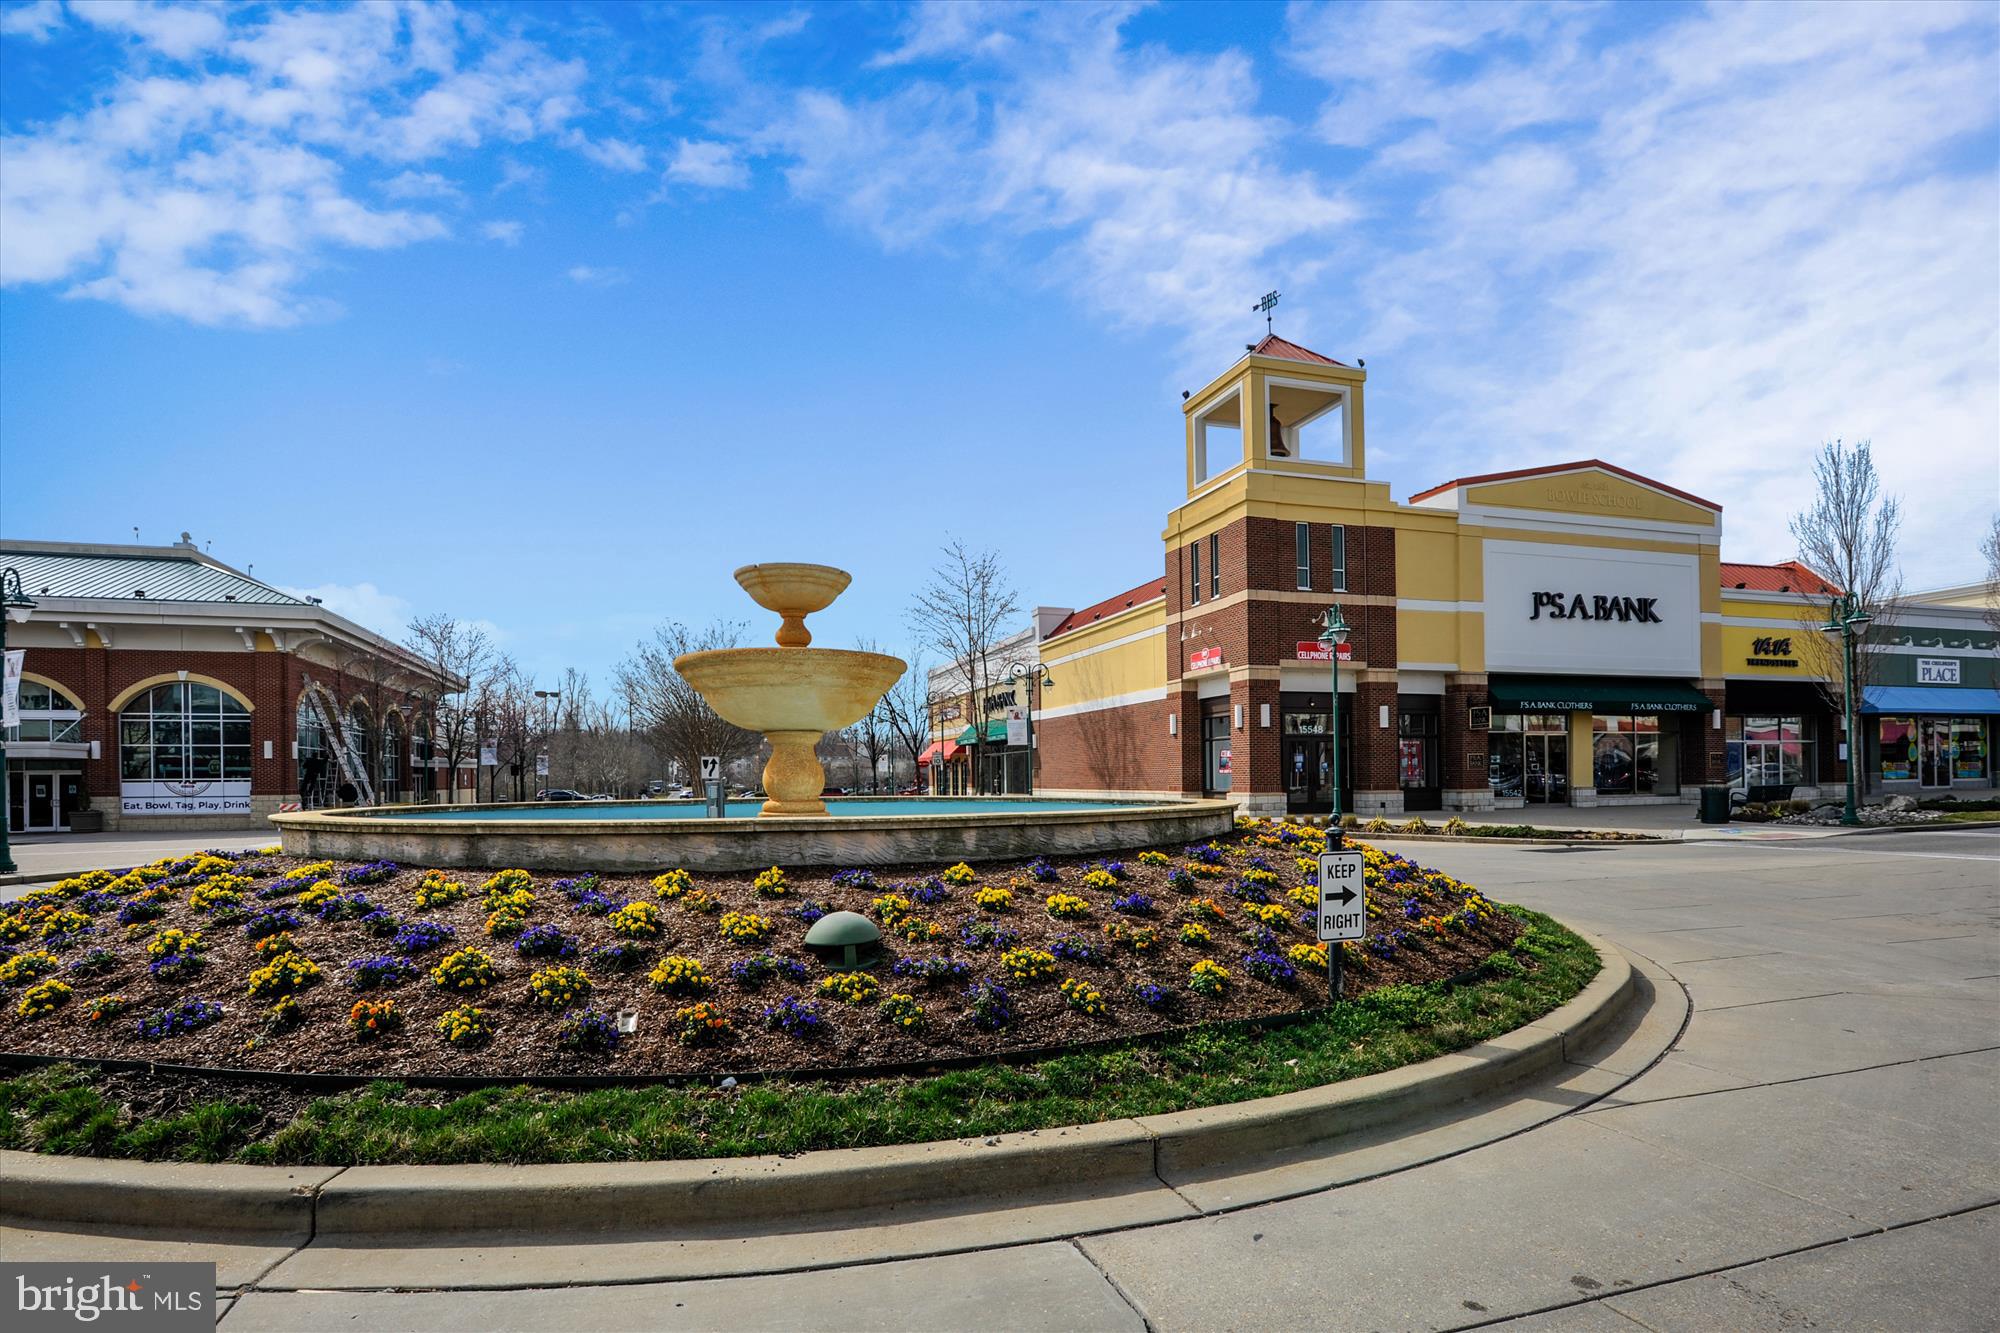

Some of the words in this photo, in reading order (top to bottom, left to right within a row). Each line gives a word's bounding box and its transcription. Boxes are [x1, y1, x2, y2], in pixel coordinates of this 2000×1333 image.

[1592, 495, 1641, 510] SCHOOL
[1329, 652, 1351, 661] RPAIRS
[1922, 667, 1958, 682] PLACE
[1557, 702, 1593, 710] CLOTHIERS
[1664, 703, 1697, 711] CLOTHIERS
[1300, 725, 1324, 734] 15548
[1502, 789, 1522, 797] 15542
[123, 802, 142, 810] Eat,
[145, 802, 173, 810] Bowl,
[175, 802, 196, 811] Tag,
[198, 801, 221, 811] Play,
[224, 801, 250, 809] Drink
[1327, 864, 1356, 879] KEEP
[1323, 913, 1360, 930] RIGHT
